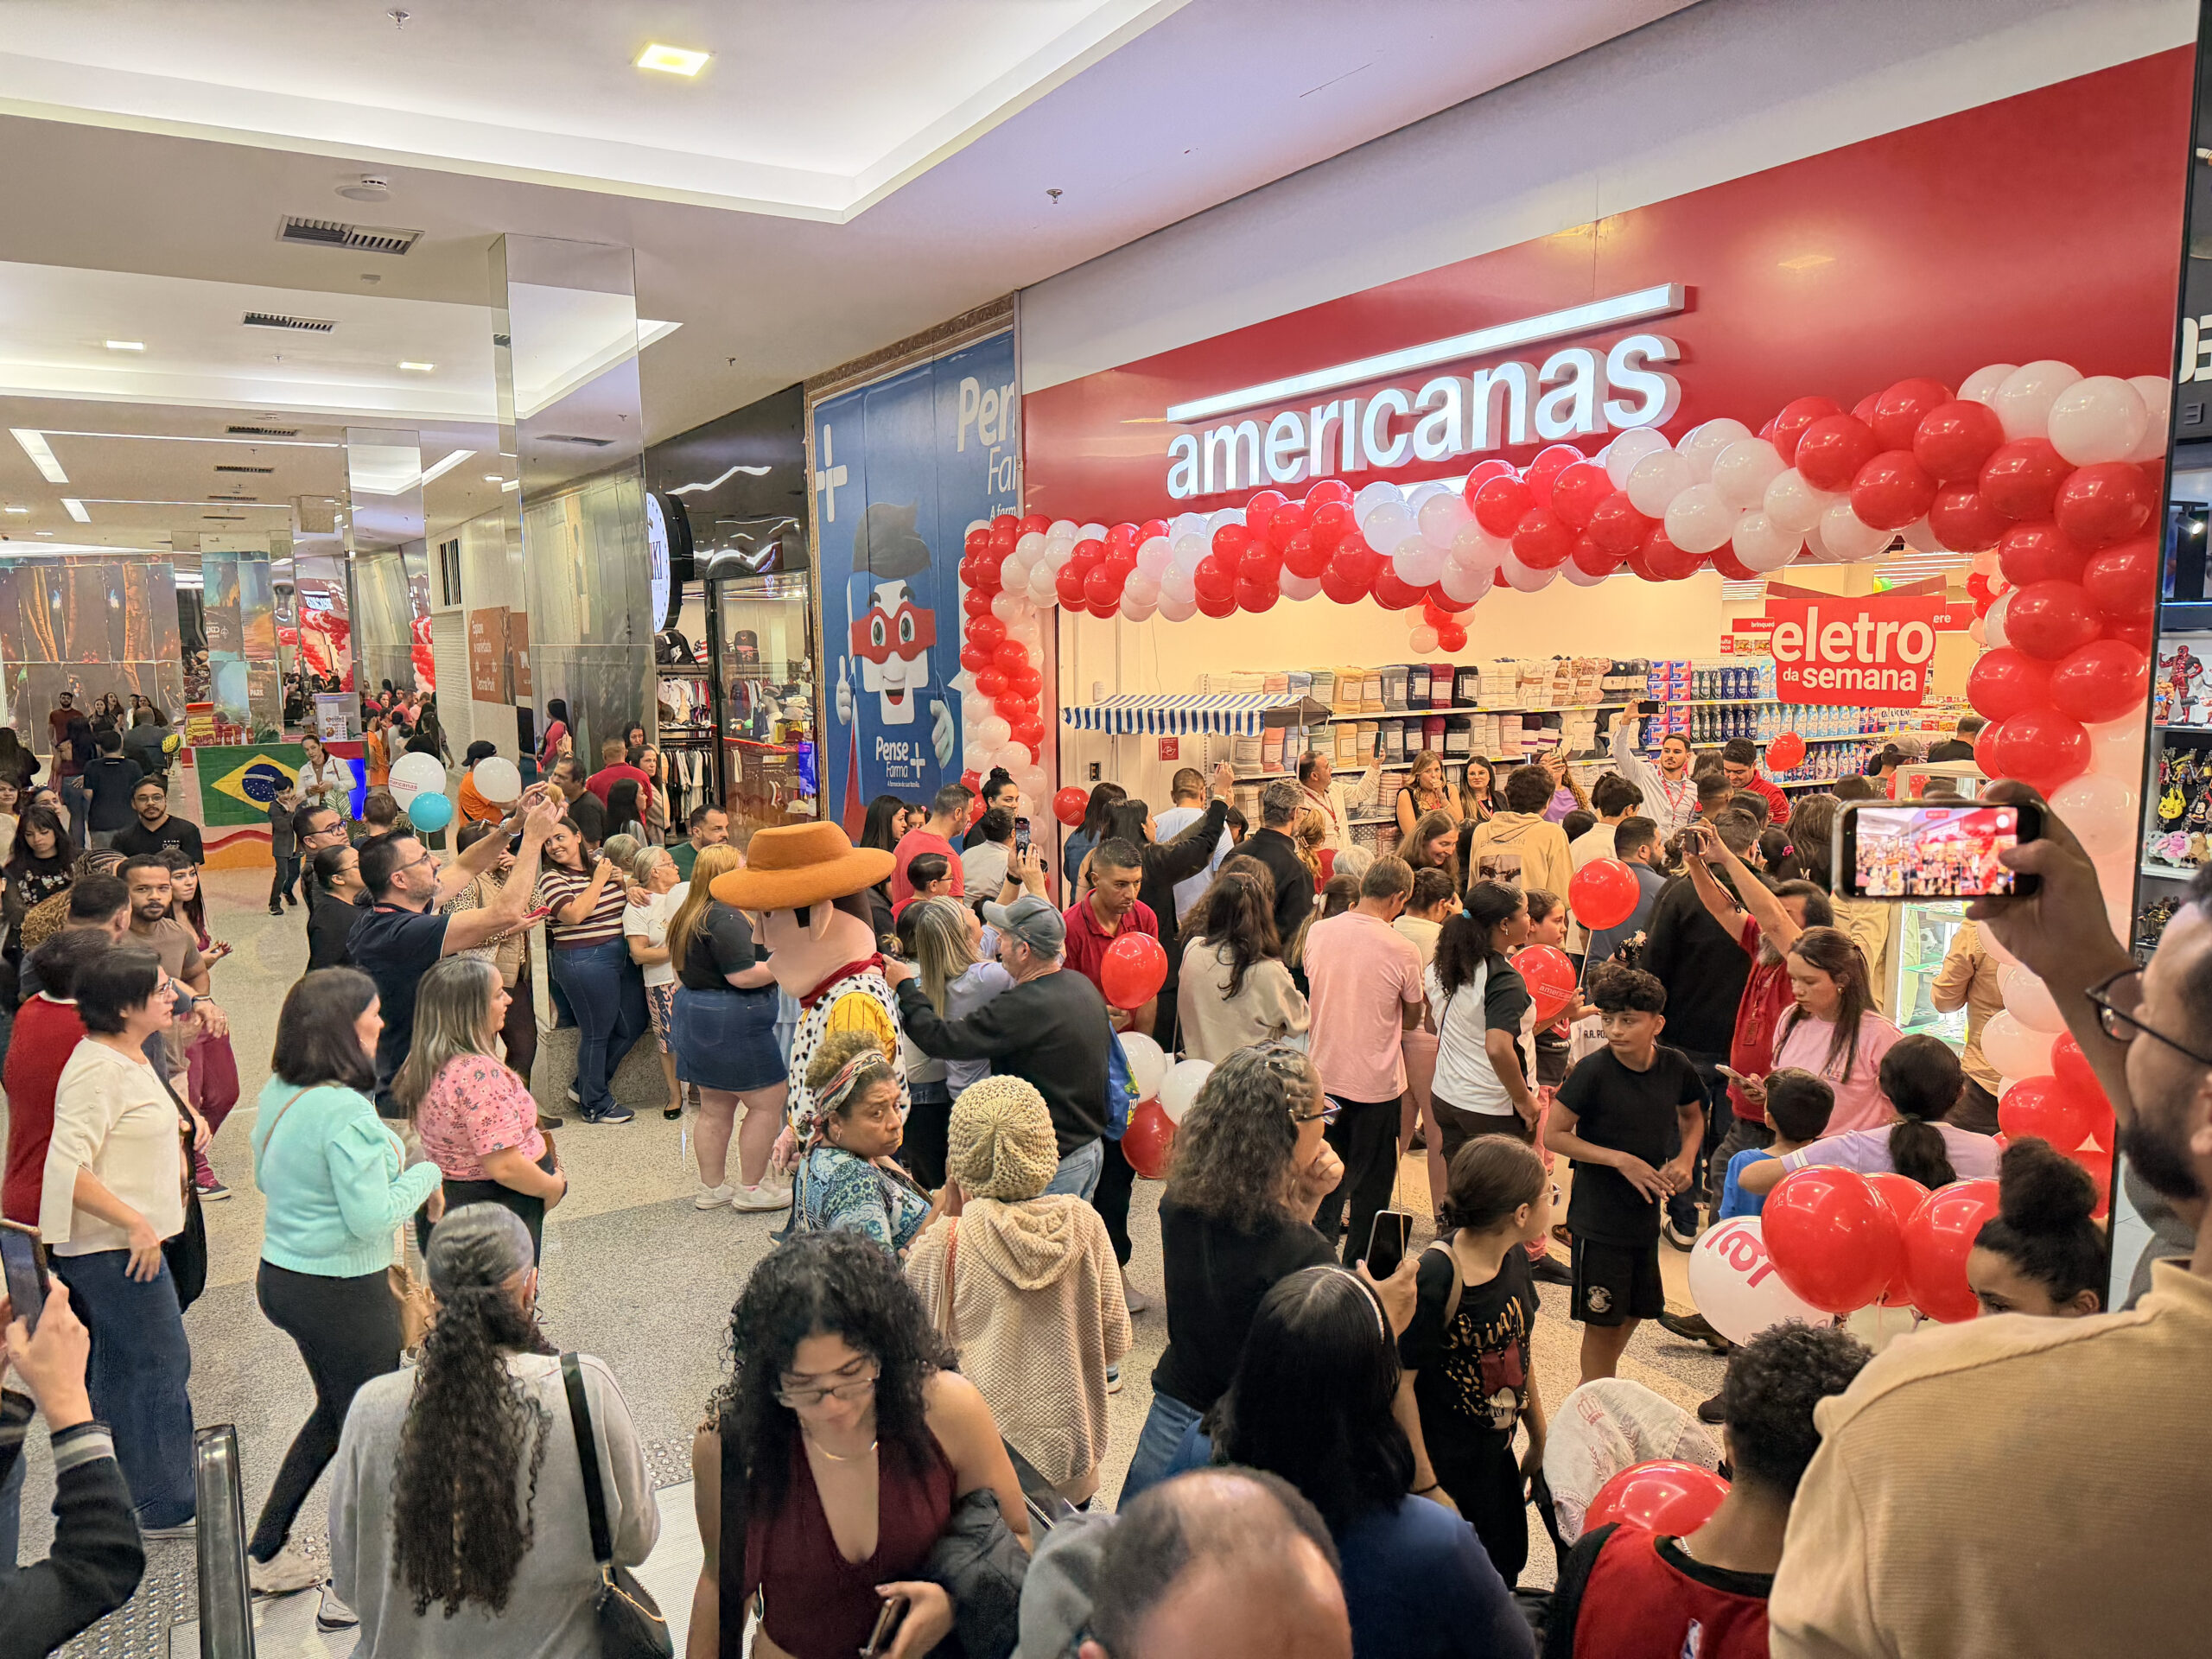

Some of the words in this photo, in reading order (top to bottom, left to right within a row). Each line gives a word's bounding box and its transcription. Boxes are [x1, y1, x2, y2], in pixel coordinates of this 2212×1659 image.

[957, 376, 1015, 453] Pen
[1166, 333, 1681, 499] americanas
[1933, 614, 1951, 624] ere
[1771, 607, 1935, 664] eletro
[1783, 667, 1799, 682] da
[1802, 667, 1916, 691] semana
[875, 735, 909, 761] Pense
[886, 761, 908, 778] Farma
[1597, 1029, 1607, 1039] PO
